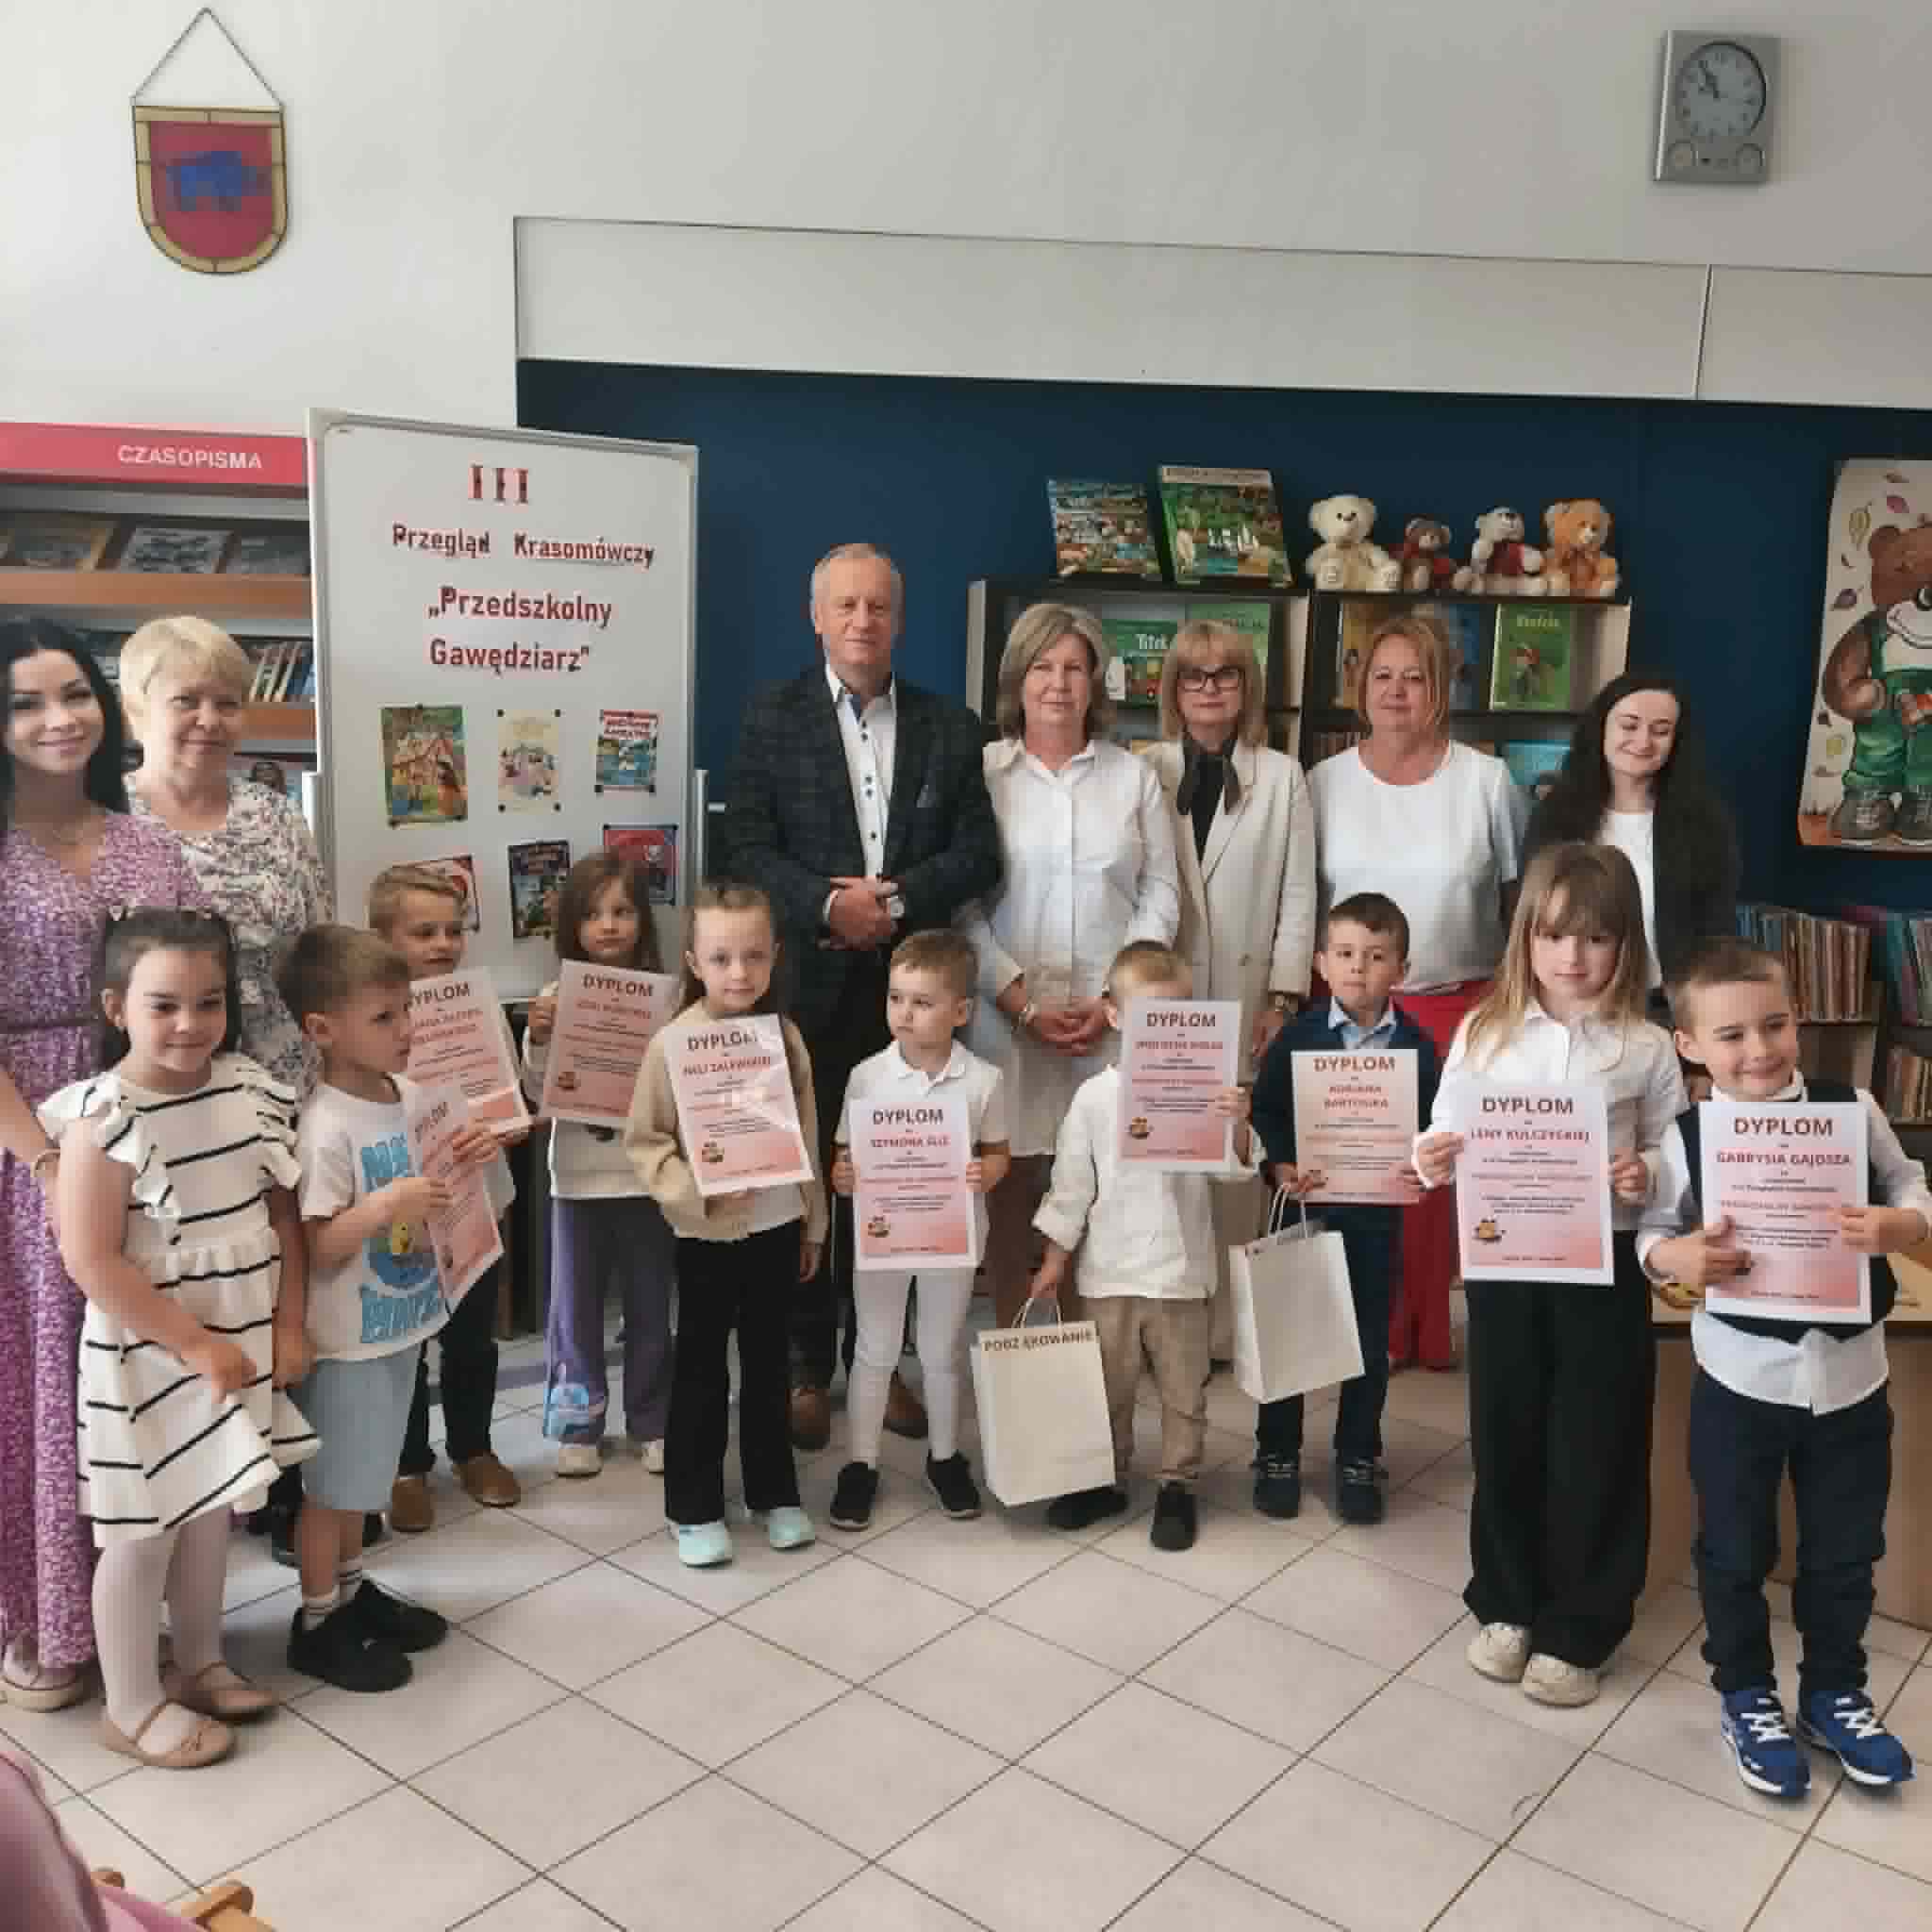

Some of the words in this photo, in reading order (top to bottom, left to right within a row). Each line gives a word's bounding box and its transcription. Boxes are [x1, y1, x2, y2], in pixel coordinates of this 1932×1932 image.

[117, 444, 262, 469] CZASOPISMA
[469, 465, 529, 504] III
[391, 523, 491, 558] Przegląd
[513, 532, 655, 570] Krasomówczy
[408, 981, 470, 1008] YPLOM
[582, 973, 653, 997] DYPLOM
[1146, 1012, 1216, 1027] DYPLOM
[1312, 1056, 1396, 1072] DYPLOM
[873, 1108, 943, 1124] DYPLOM
[1482, 1096, 1574, 1114] DYPLOM
[1734, 1117, 1834, 1137] DYPLOM
